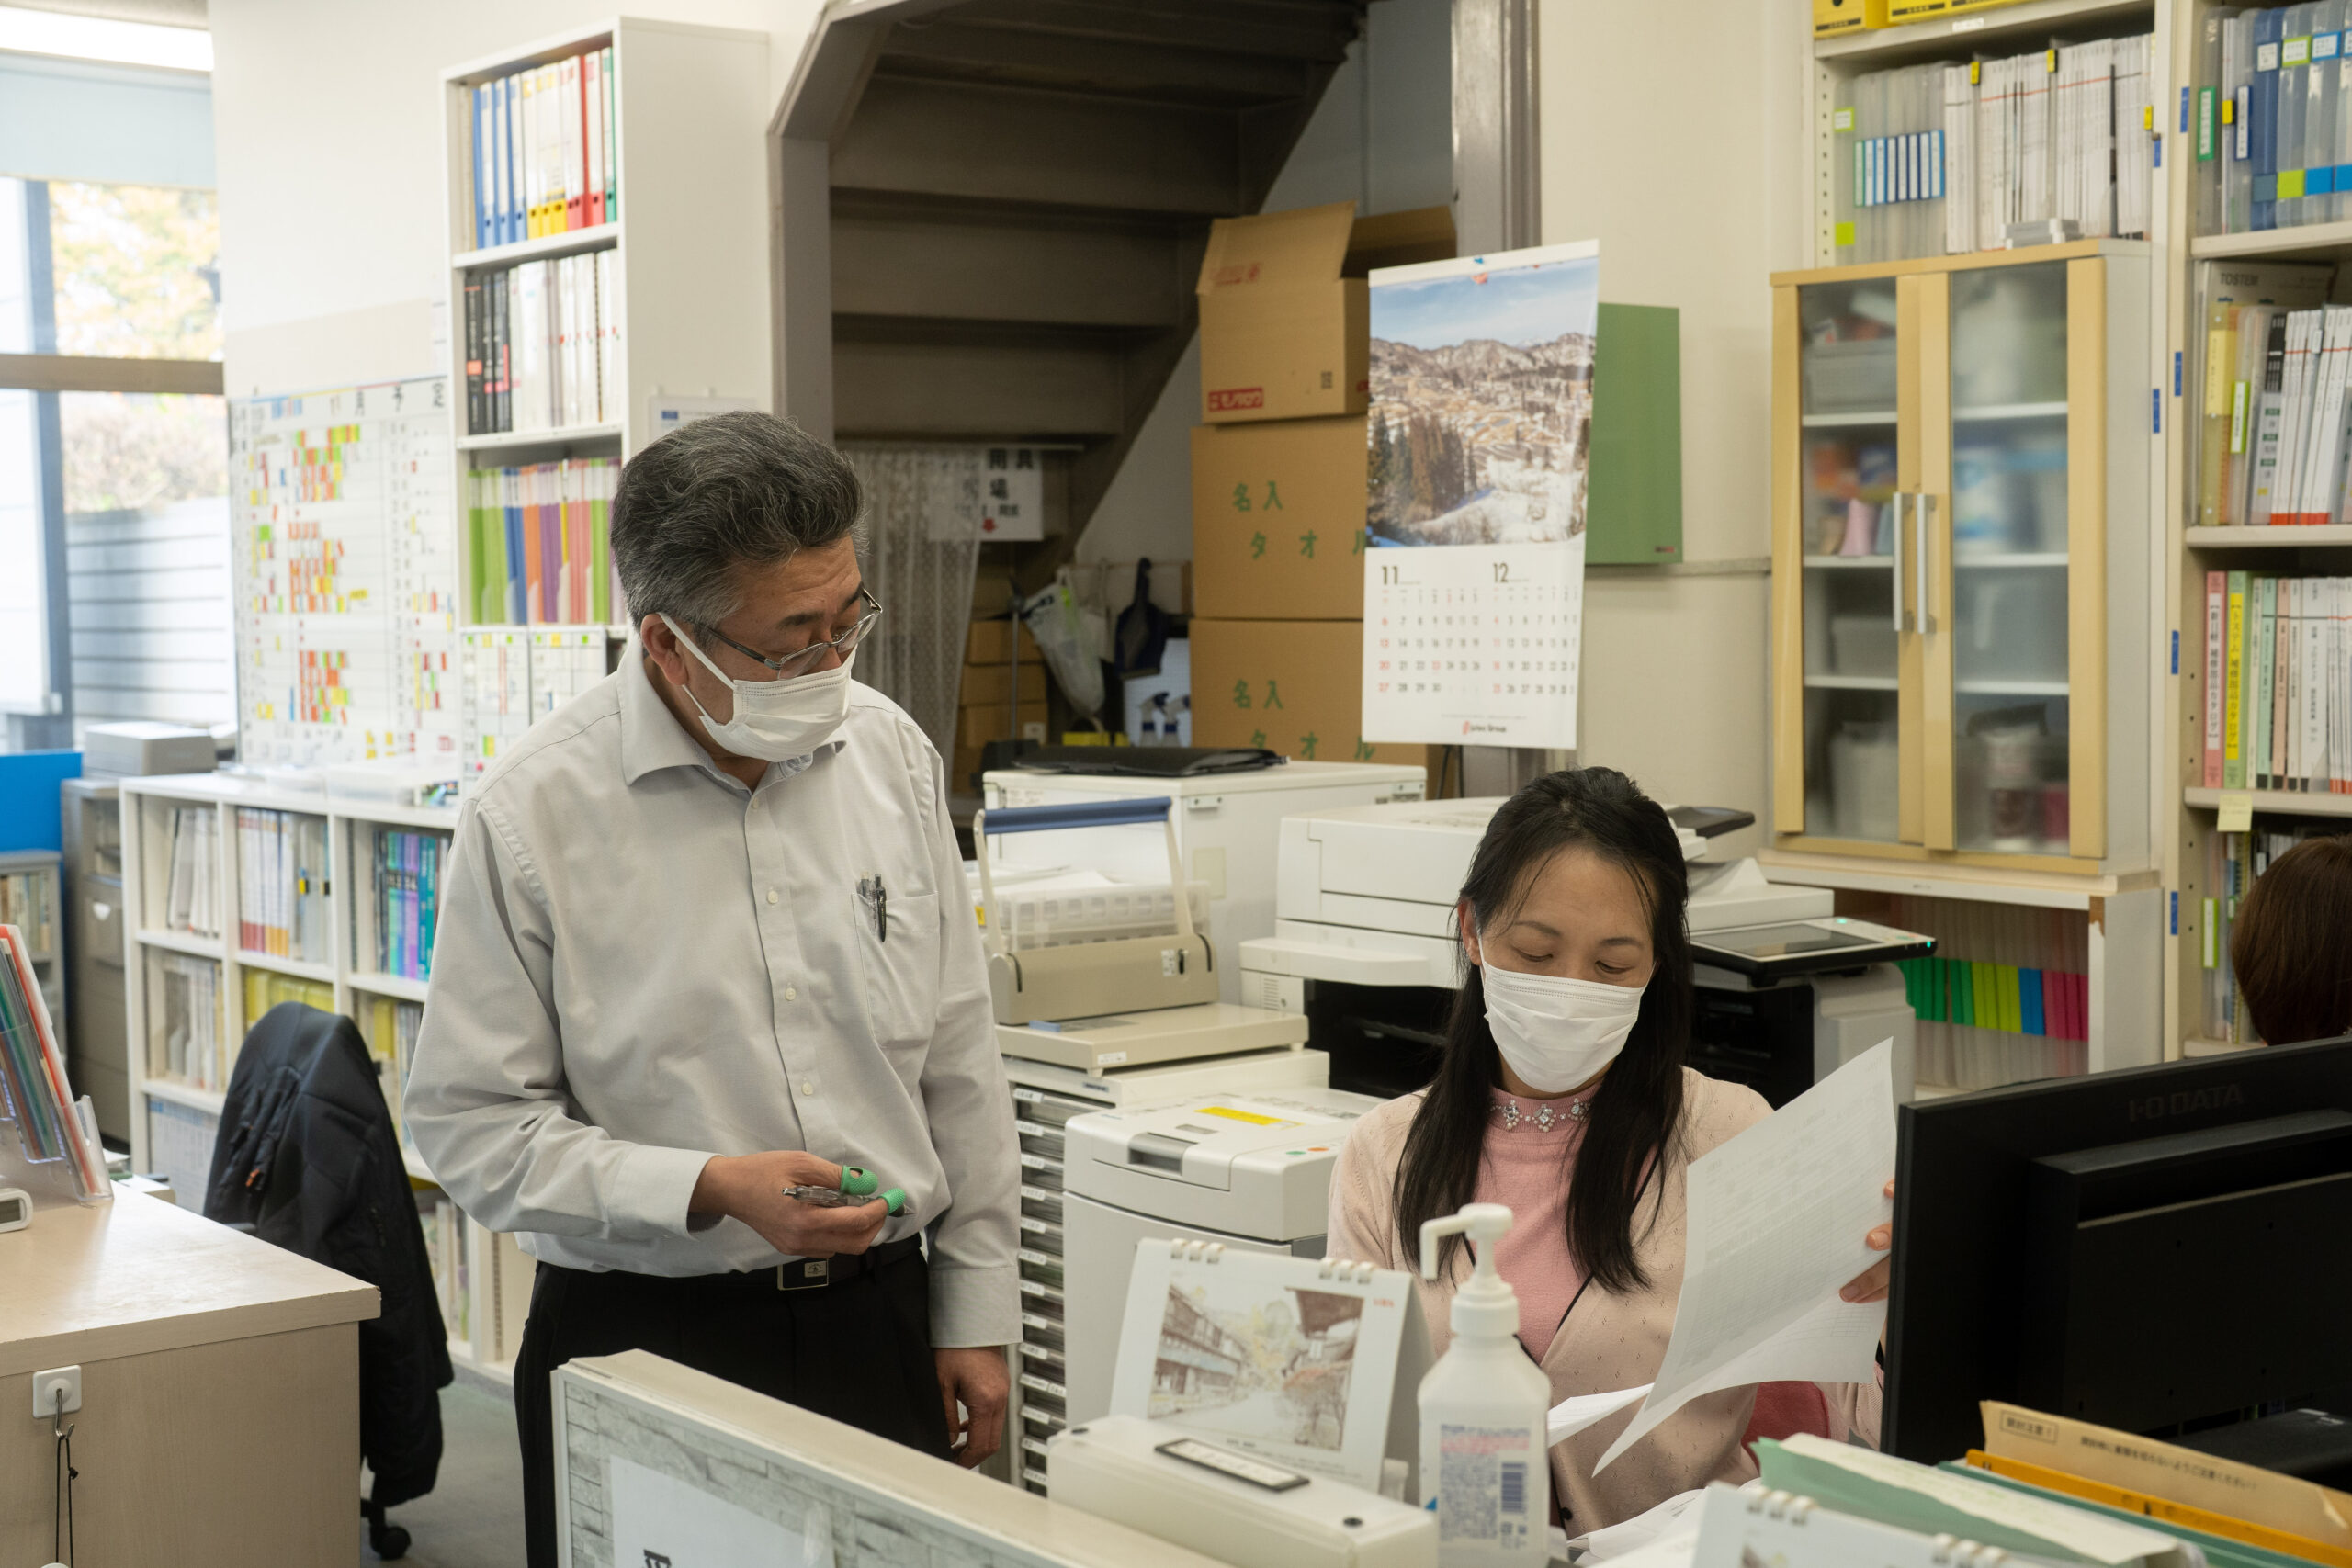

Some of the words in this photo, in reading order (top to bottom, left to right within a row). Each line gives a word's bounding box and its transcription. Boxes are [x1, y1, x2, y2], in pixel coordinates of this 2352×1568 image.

[1381, 565, 1398, 585] 11
[1493, 563, 1509, 583] 12
[2169, 1083, 2243, 1116] DATA
